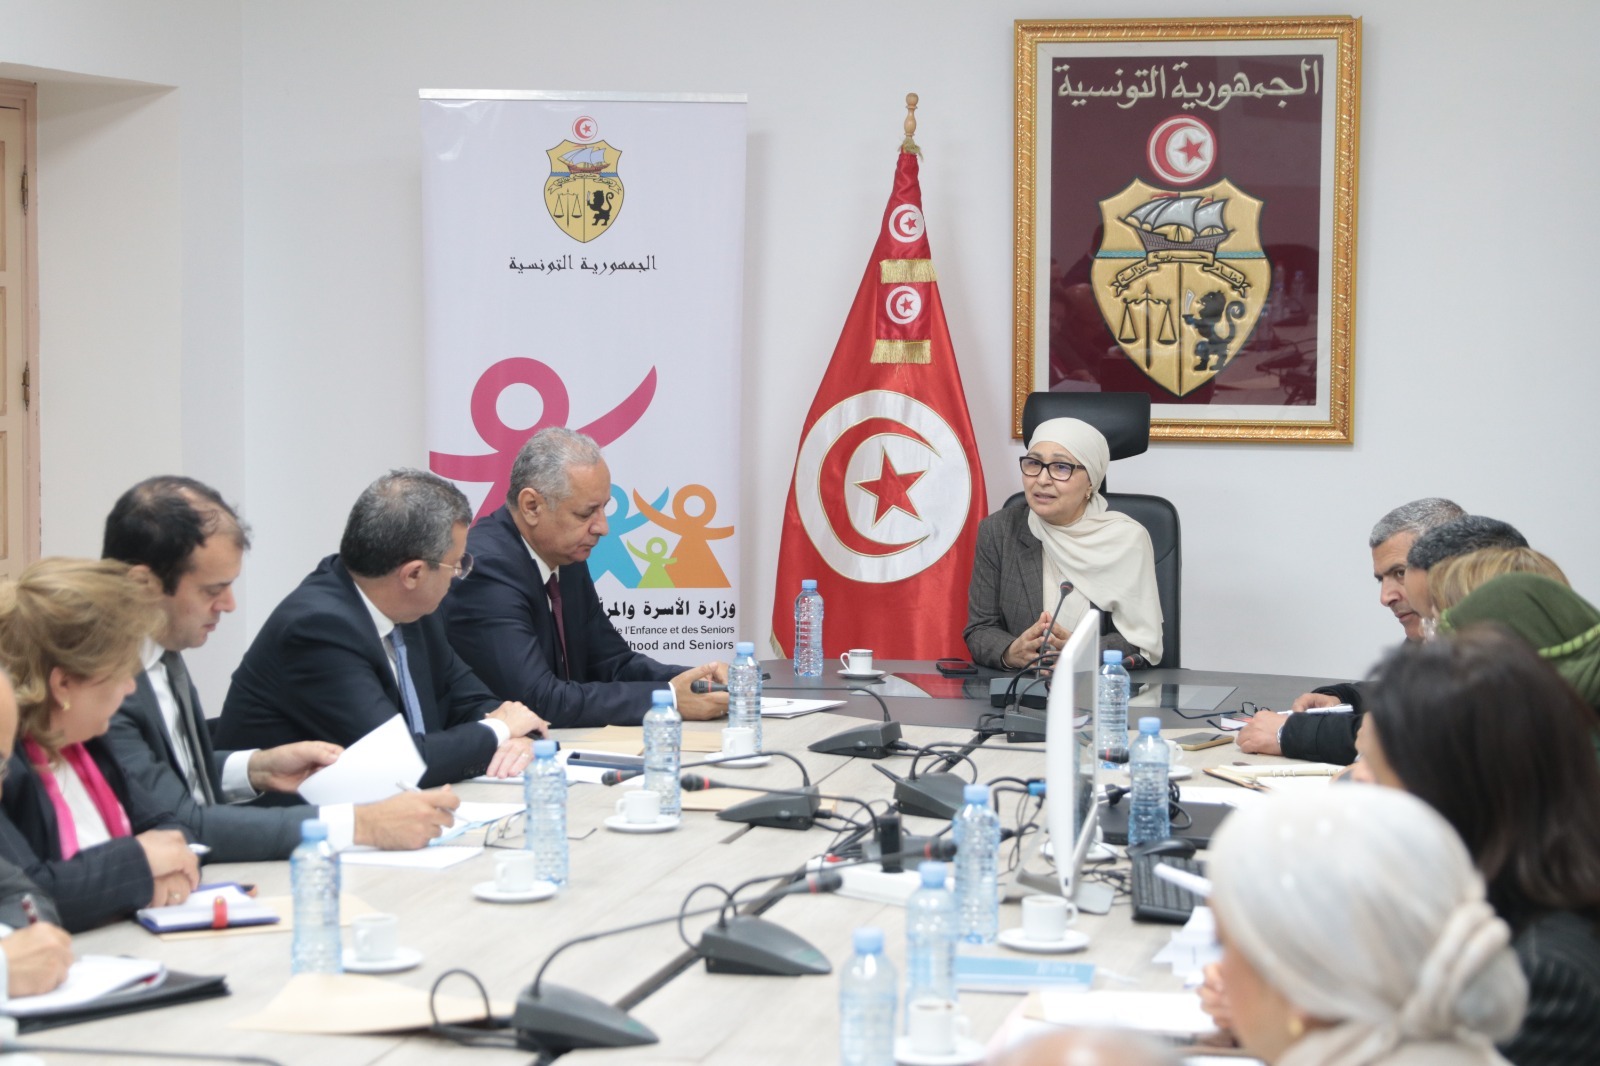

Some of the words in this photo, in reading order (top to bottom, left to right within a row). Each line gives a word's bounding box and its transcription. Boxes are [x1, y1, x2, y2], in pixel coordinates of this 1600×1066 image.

[1054, 63, 1166, 109] التونسية
[1171, 58, 1320, 111] الجمهورية
[509, 254, 574, 276] التونسية
[580, 254, 658, 276] الجمهورية
[599, 597, 635, 620] والمرأ
[643, 597, 690, 619] الأسرة
[698, 600, 736, 619] وزارة
[625, 625, 668, 635] l'Enfance
[669, 626, 679, 634] et
[681, 625, 699, 634] des
[700, 625, 735, 634] Seniors
[626, 640, 659, 651] hood
[662, 639, 686, 650] and
[689, 639, 734, 650] Seniors
